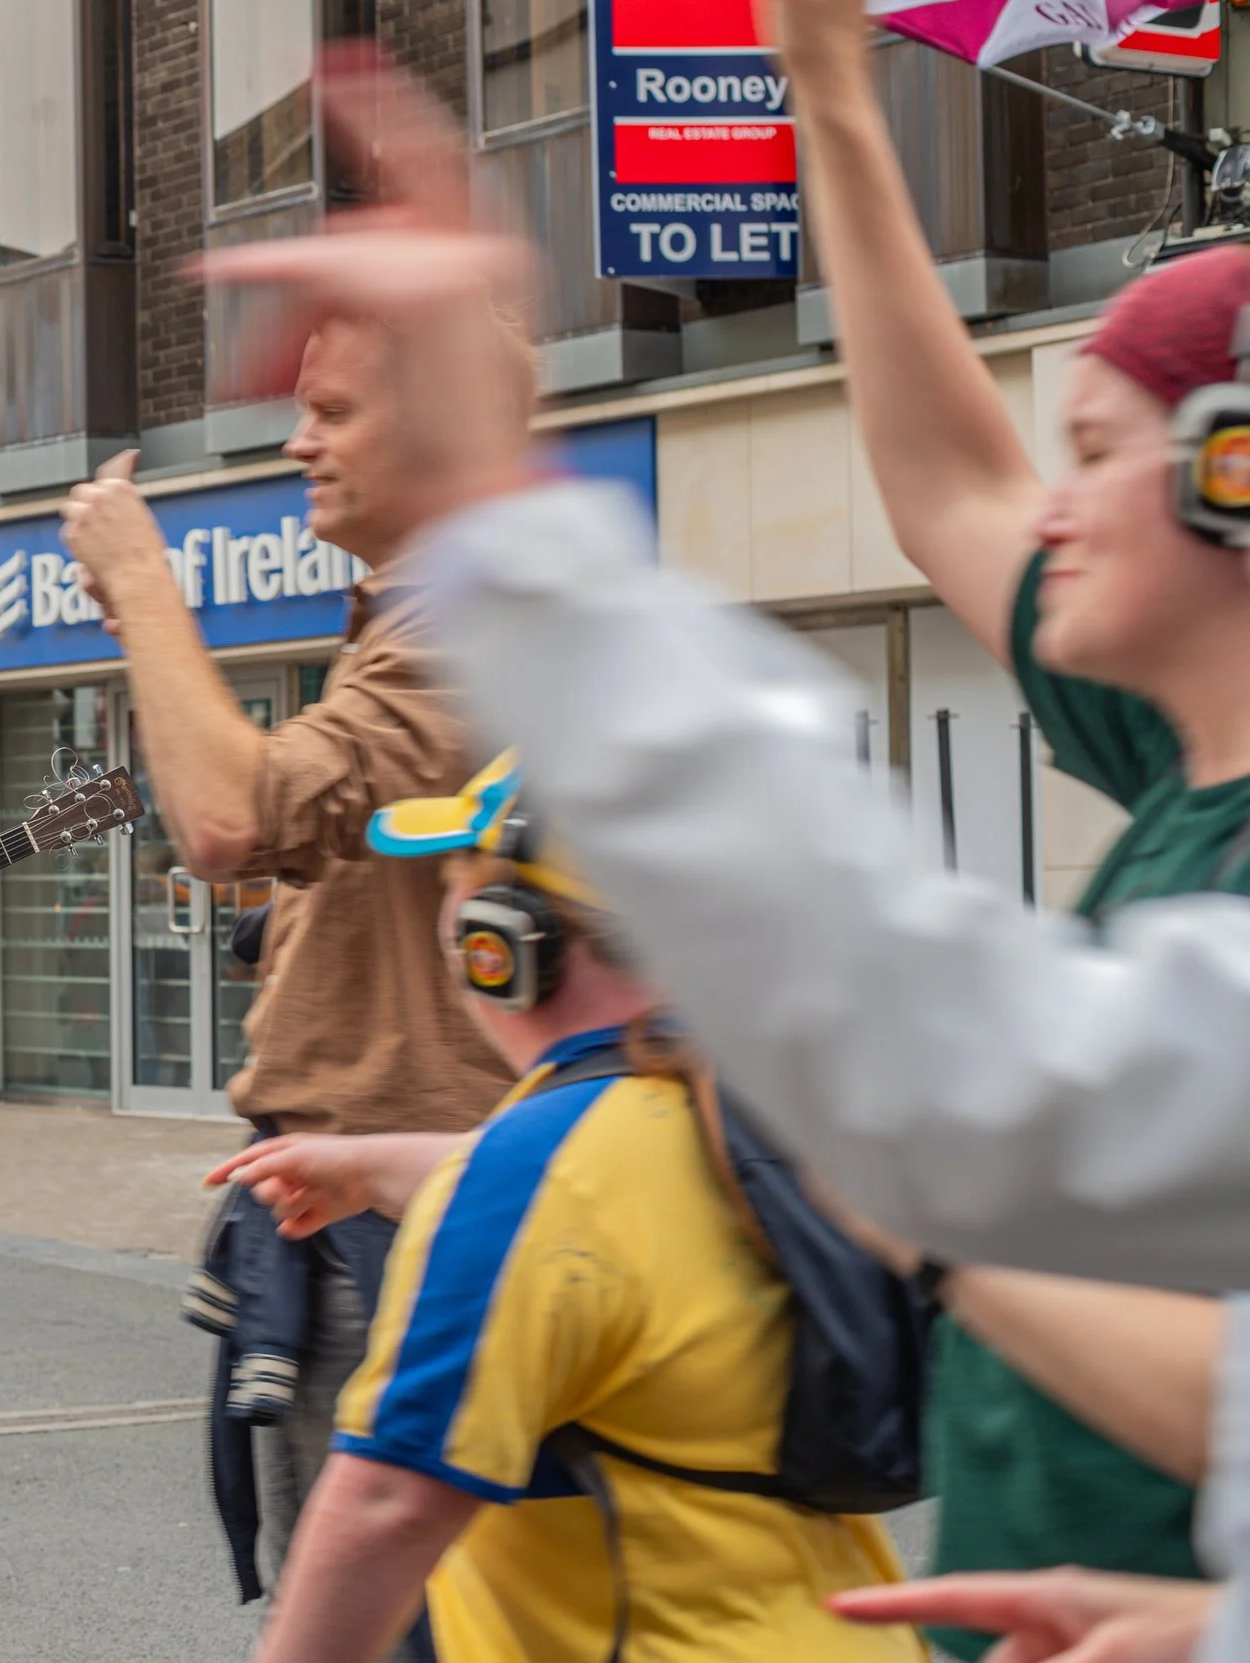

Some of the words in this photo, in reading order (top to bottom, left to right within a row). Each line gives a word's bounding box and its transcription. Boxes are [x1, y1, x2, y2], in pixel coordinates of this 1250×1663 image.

[635, 68, 789, 110] Rooney
[648, 126, 683, 140] REAL
[684, 126, 730, 140] ESTATE
[731, 126, 777, 140] GROUP
[610, 192, 749, 212] COMMERCIAL
[751, 192, 800, 212] SPAC
[629, 222, 697, 262] TO
[710, 222, 800, 262] LET
[31, 552, 105, 629] Ba
[212, 515, 374, 606] Irelan
